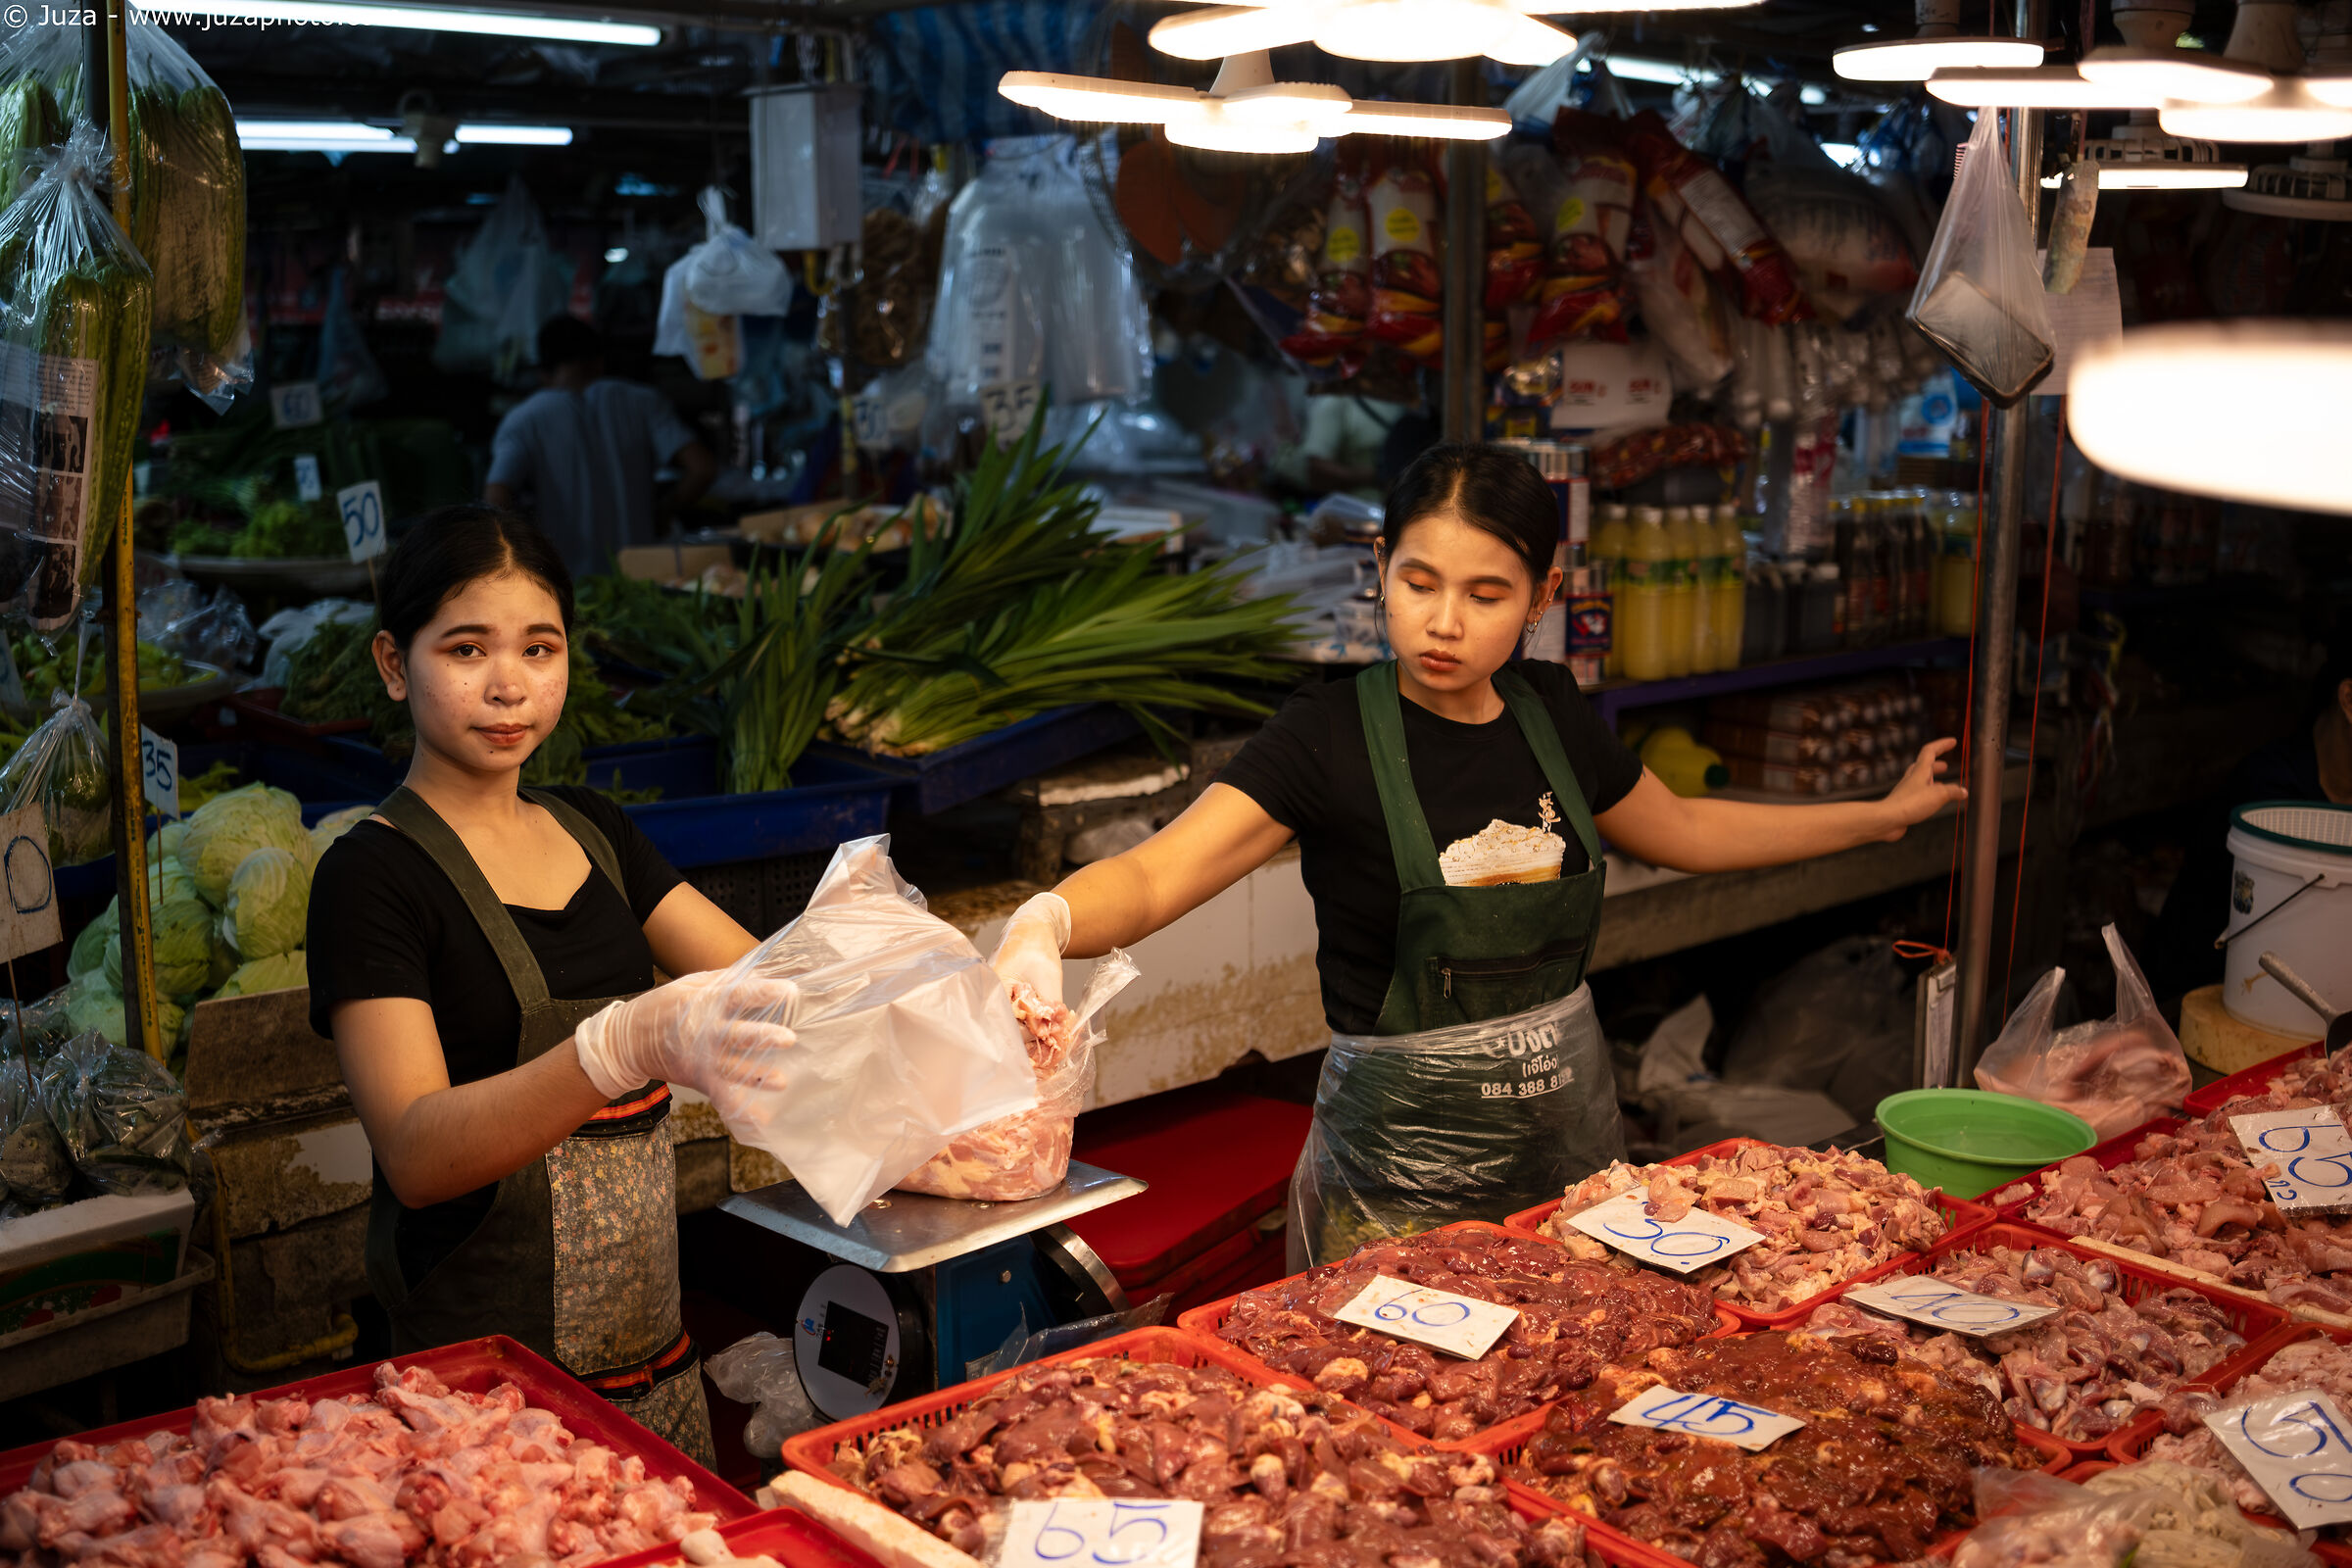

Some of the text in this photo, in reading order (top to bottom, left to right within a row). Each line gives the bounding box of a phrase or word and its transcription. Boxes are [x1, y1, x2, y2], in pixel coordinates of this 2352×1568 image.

[342, 491, 379, 548] 50
[142, 740, 172, 792] 35
[1481, 1082, 1513, 1097] 084
[1518, 1078, 1545, 1097] 388
[1374, 1288, 1471, 1327] 60
[1641, 1395, 1779, 1436] 45
[1035, 1500, 1172, 1565] 65
